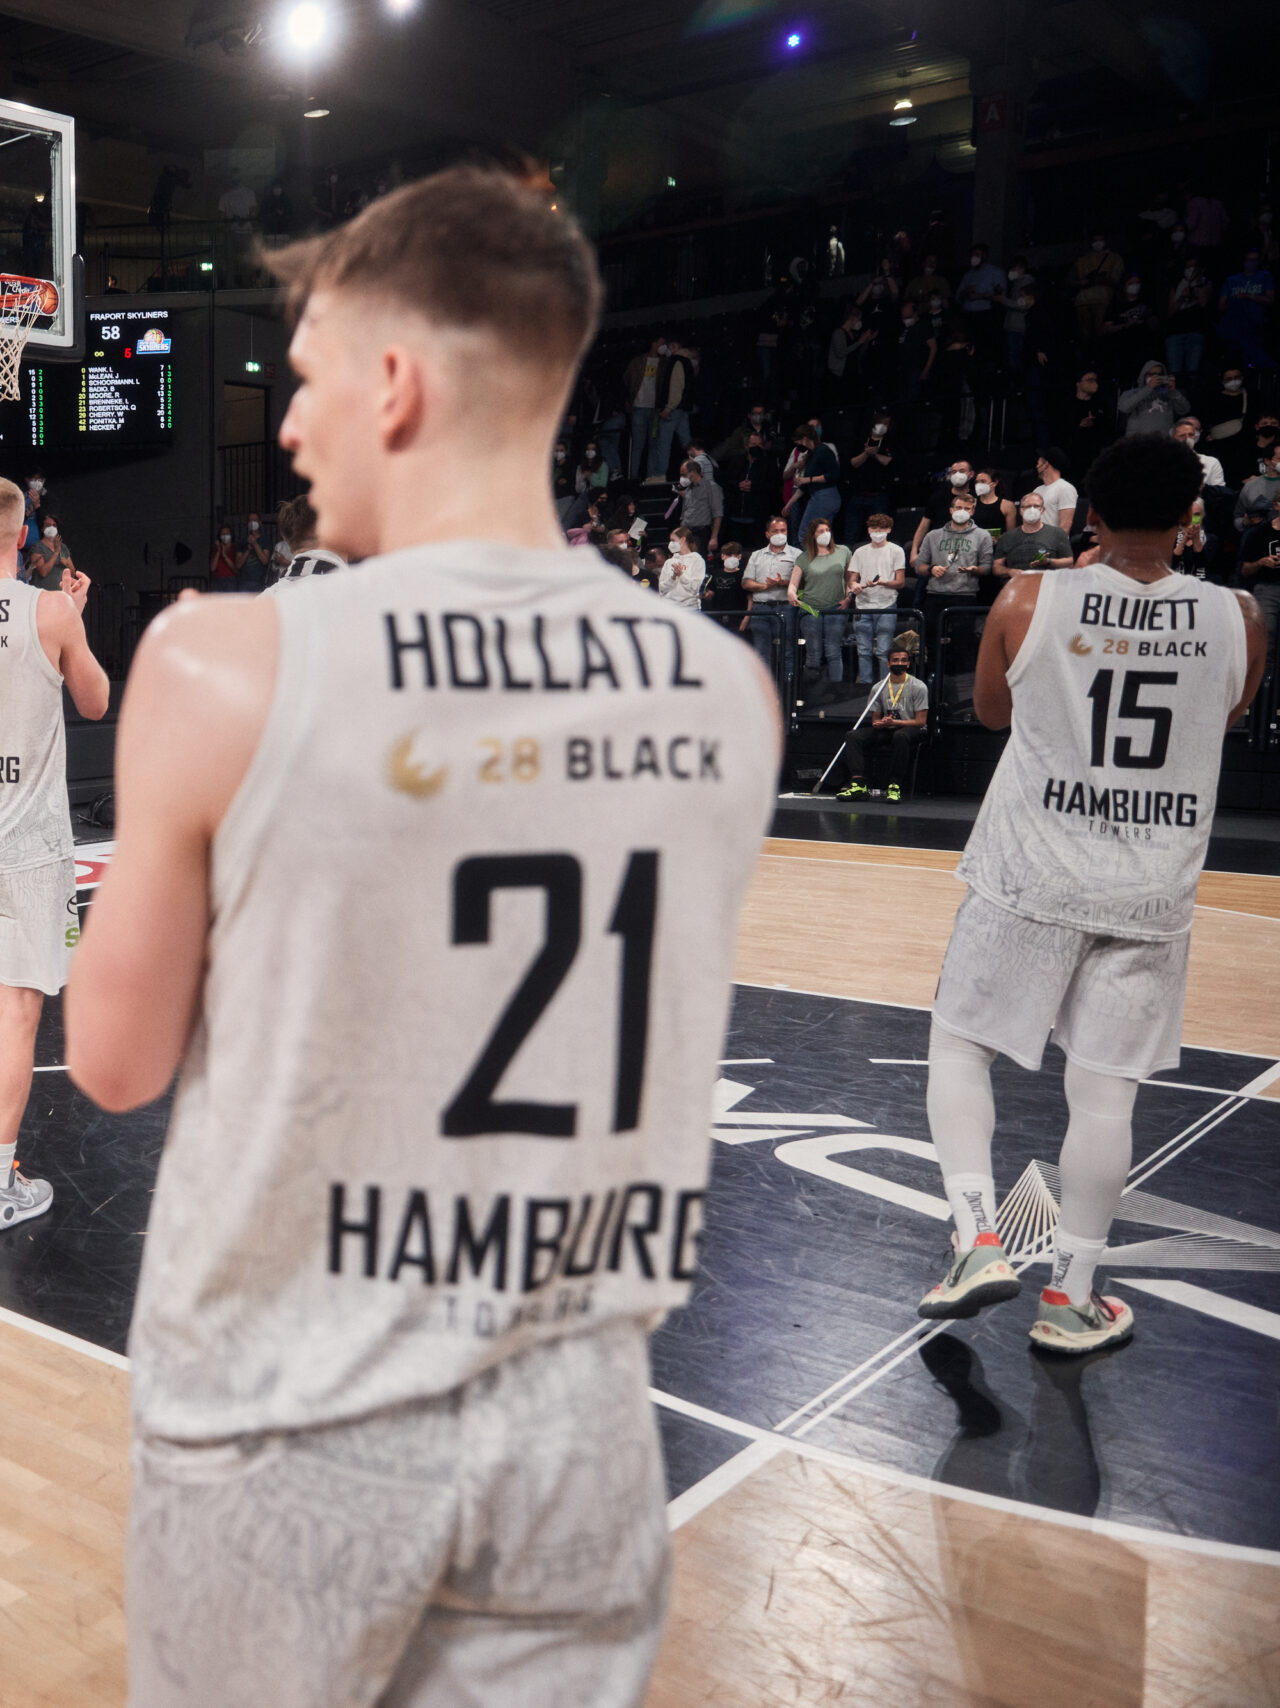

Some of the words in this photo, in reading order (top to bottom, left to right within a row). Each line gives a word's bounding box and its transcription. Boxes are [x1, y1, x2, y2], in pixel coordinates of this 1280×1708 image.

[90, 312, 125, 320] FRAPORT
[127, 311, 168, 319] SKYLINERS
[101, 326, 120, 340] 58
[1080, 593, 1198, 631] BLUIETT
[383, 611, 707, 691] HOLLATZ
[1102, 639, 1130, 655] 28
[1138, 641, 1207, 657] BLACK
[1086, 669, 1178, 769] 15
[477, 737, 541, 783] 28
[565, 736, 725, 782] BLACK
[1043, 778, 1198, 827] HAMBURG
[1089, 820, 1151, 840] TOWERS
[440, 849, 661, 1139] 21
[1052, 1249, 1074, 1288] PALDING
